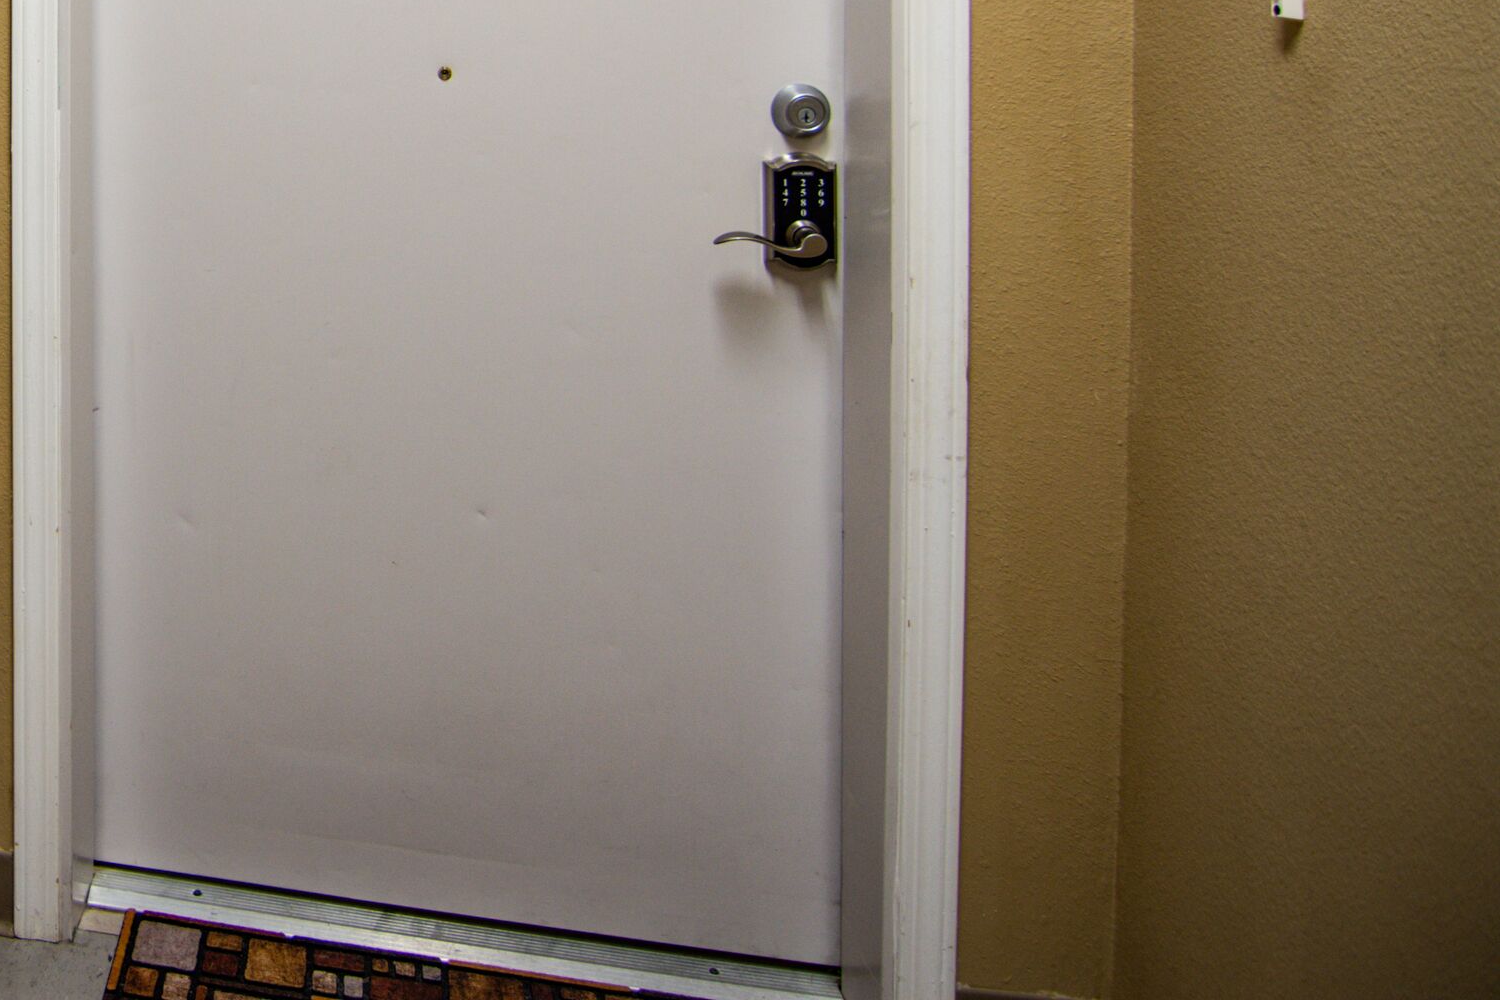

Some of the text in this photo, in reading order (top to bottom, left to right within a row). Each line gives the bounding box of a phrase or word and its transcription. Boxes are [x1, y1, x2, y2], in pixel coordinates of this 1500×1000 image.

[800, 178, 807, 187] 2
[818, 178, 824, 187] 3
[782, 188, 824, 197] 4 5 6
[782, 198, 824, 207] 7 8 9
[800, 208, 807, 217] 0
